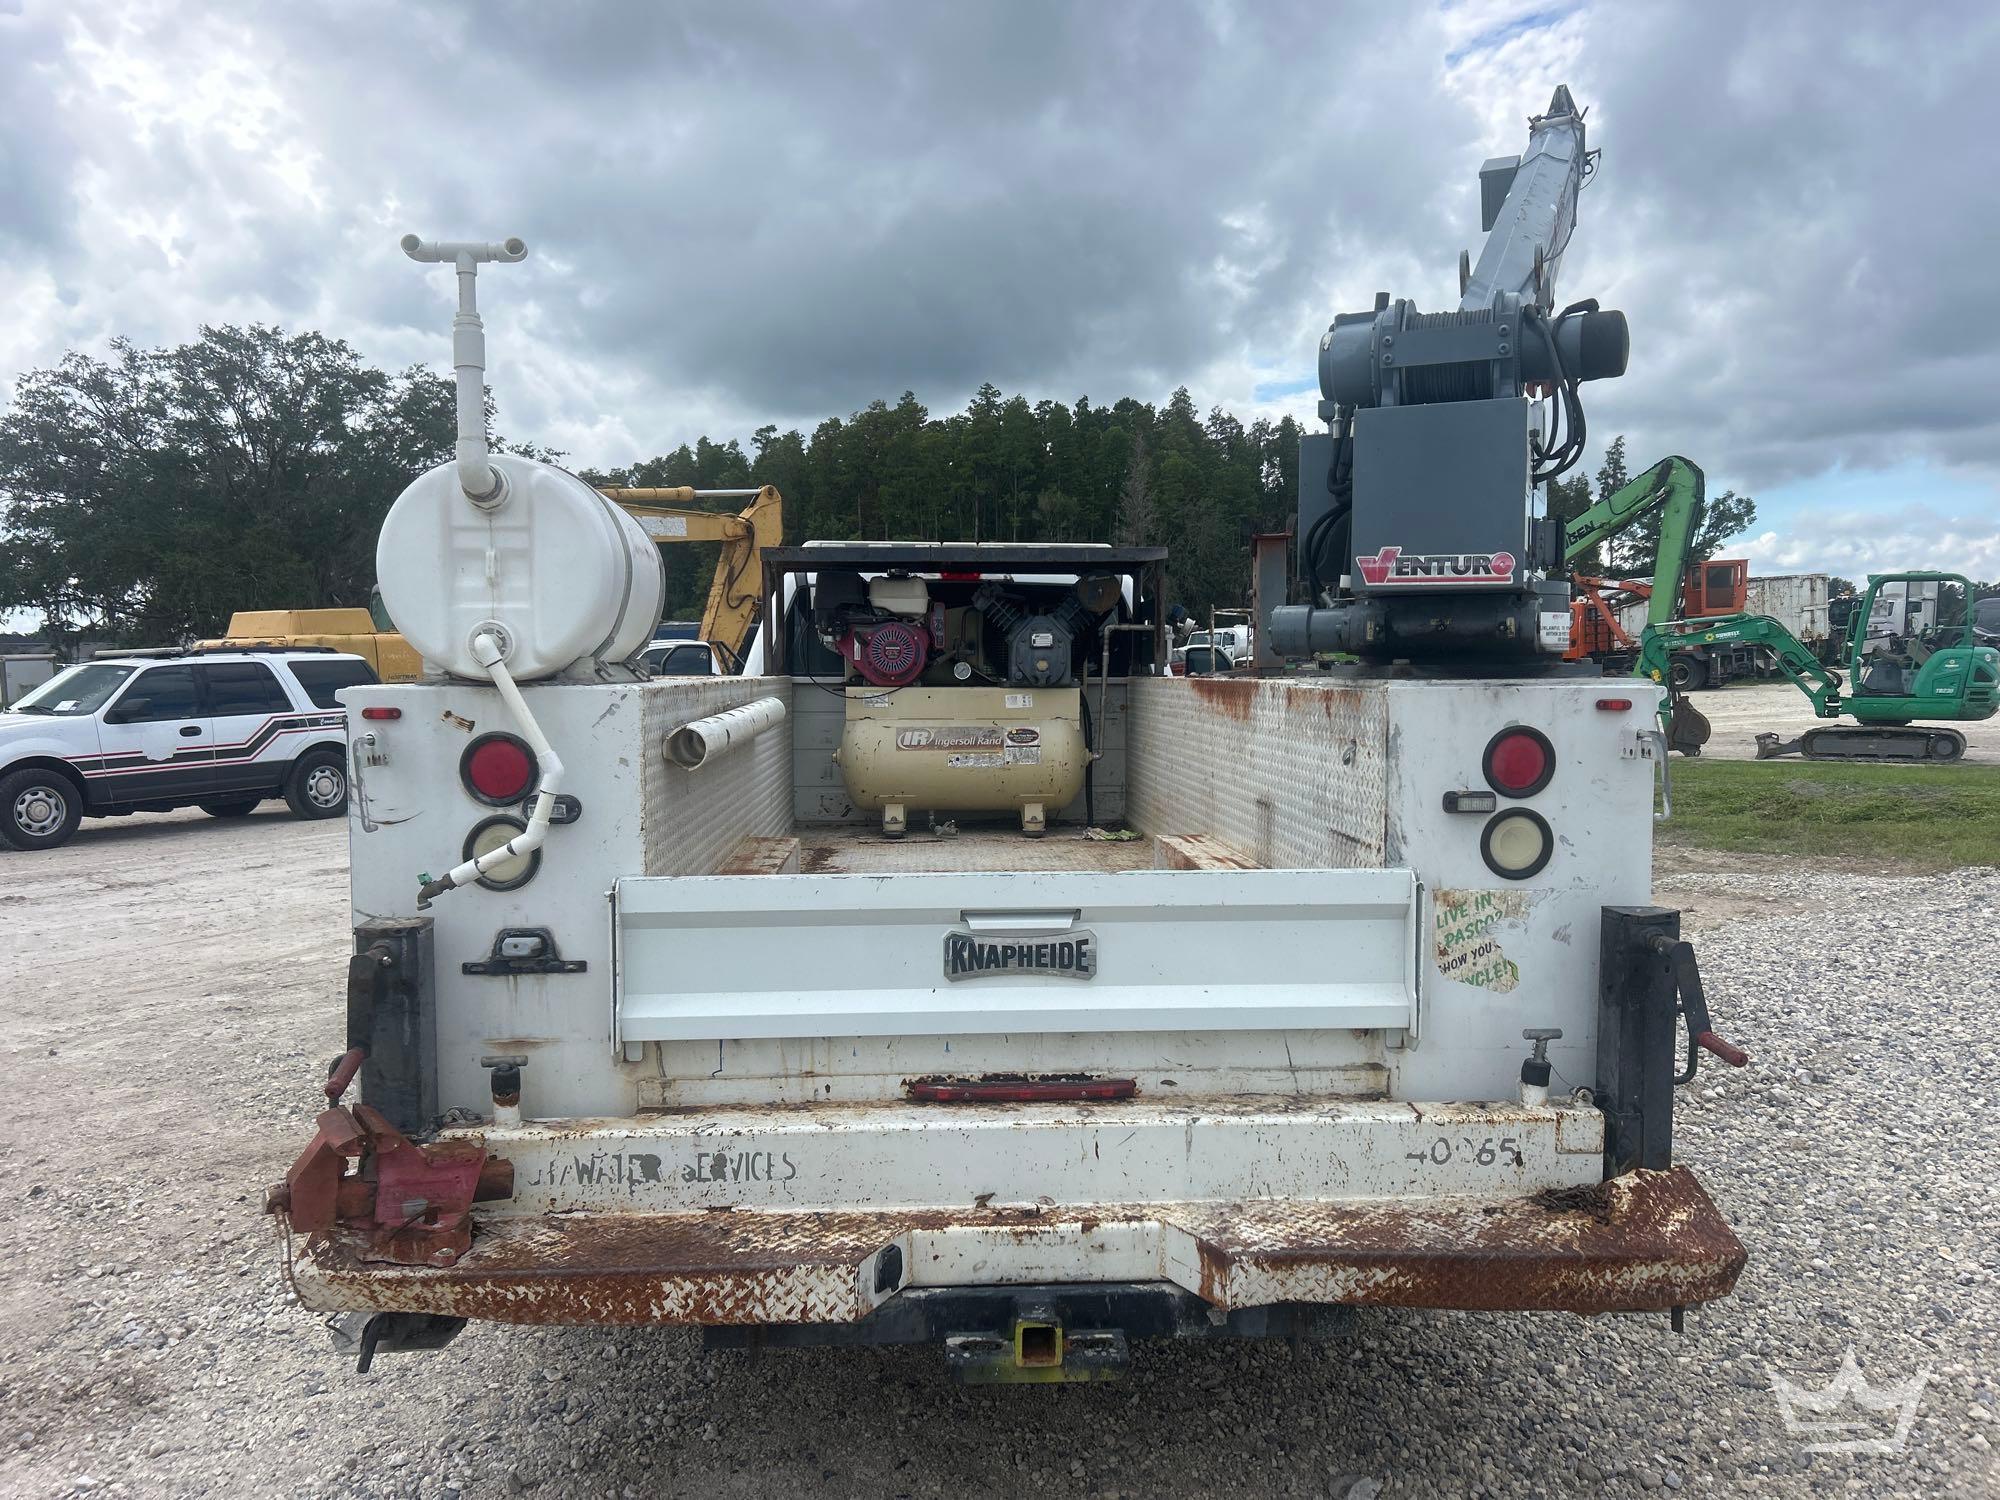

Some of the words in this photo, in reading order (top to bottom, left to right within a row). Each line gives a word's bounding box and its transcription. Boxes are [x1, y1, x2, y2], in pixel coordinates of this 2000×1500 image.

[1566, 520, 1597, 549] GEN
[1357, 547, 1515, 585] VENTURO
[903, 731, 930, 746] IR
[934, 737, 976, 748] Ingersoll
[977, 736, 1002, 746] Rand
[1436, 902, 1469, 930] LIVE
[1474, 891, 1493, 911] IN
[951, 937, 1090, 975] KNAPHEIDE
[1471, 942, 1493, 960] YOU
